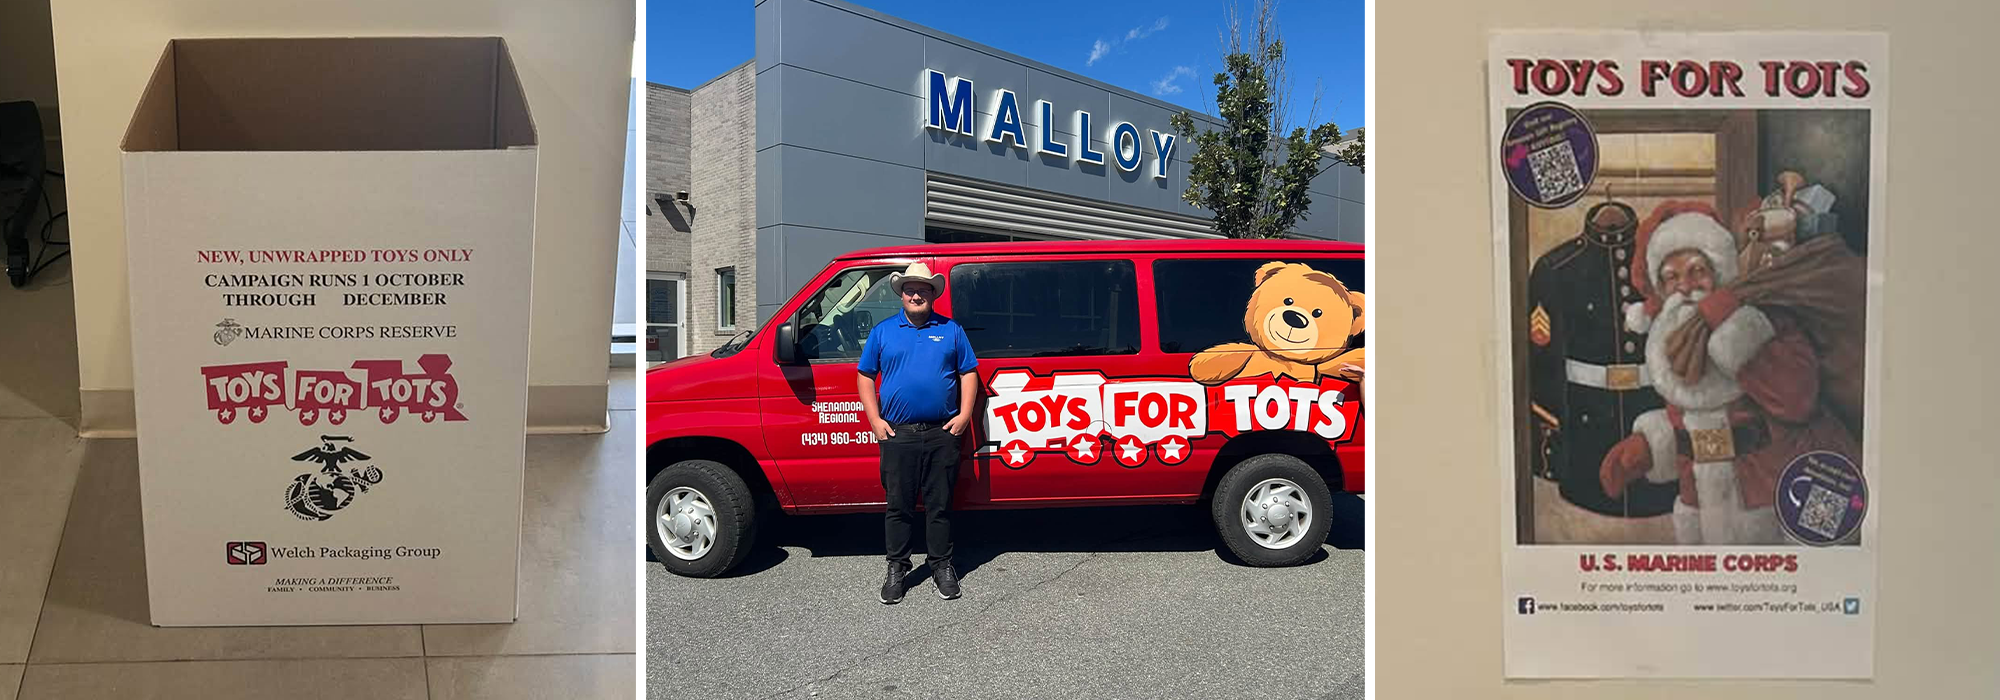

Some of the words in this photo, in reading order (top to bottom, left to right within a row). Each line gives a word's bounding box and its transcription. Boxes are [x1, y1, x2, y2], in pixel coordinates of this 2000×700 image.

[1507, 59, 1624, 97] TOYS
[1641, 60, 1745, 98] FOR
[1759, 61, 1871, 99] TOTS
[925, 68, 1176, 179] MALLOY
[197, 250, 245, 265] NEW,
[249, 250, 367, 264] UNWRAPPED
[371, 249, 419, 263] TOYS
[424, 249, 473, 263] ONLY
[204, 273, 305, 288] CAMPAIGN
[309, 273, 358, 288] RUNS
[362, 273, 369, 287] 1
[375, 272, 465, 287] OCTOBER
[223, 293, 316, 307] THROUGH
[343, 292, 447, 306] DECEMBER
[245, 326, 315, 339] MARINE
[318, 326, 375, 340] CORPS
[379, 325, 457, 339] RESERVE
[208, 370, 282, 403] TOYS
[297, 378, 351, 406] FOR
[371, 377, 448, 408] TOTS
[993, 395, 1090, 434] TOYS
[1113, 392, 1196, 430] FOR
[1224, 384, 1346, 440] TOTS
[801, 432, 828, 446] (434)
[271, 547, 315, 558] Welch
[320, 547, 392, 560] Packaging
[395, 546, 441, 559] Group
[1579, 554, 1622, 572] U.S.
[1627, 554, 1716, 572] MARINE
[1722, 554, 1799, 572] CORPS
[327, 576, 393, 585] DIFFERENCE
[1581, 582, 1597, 592] For
[1600, 583, 1623, 592] more
[1626, 582, 1677, 592] information
[1680, 583, 1692, 594] go
[1695, 583, 1704, 592] to
